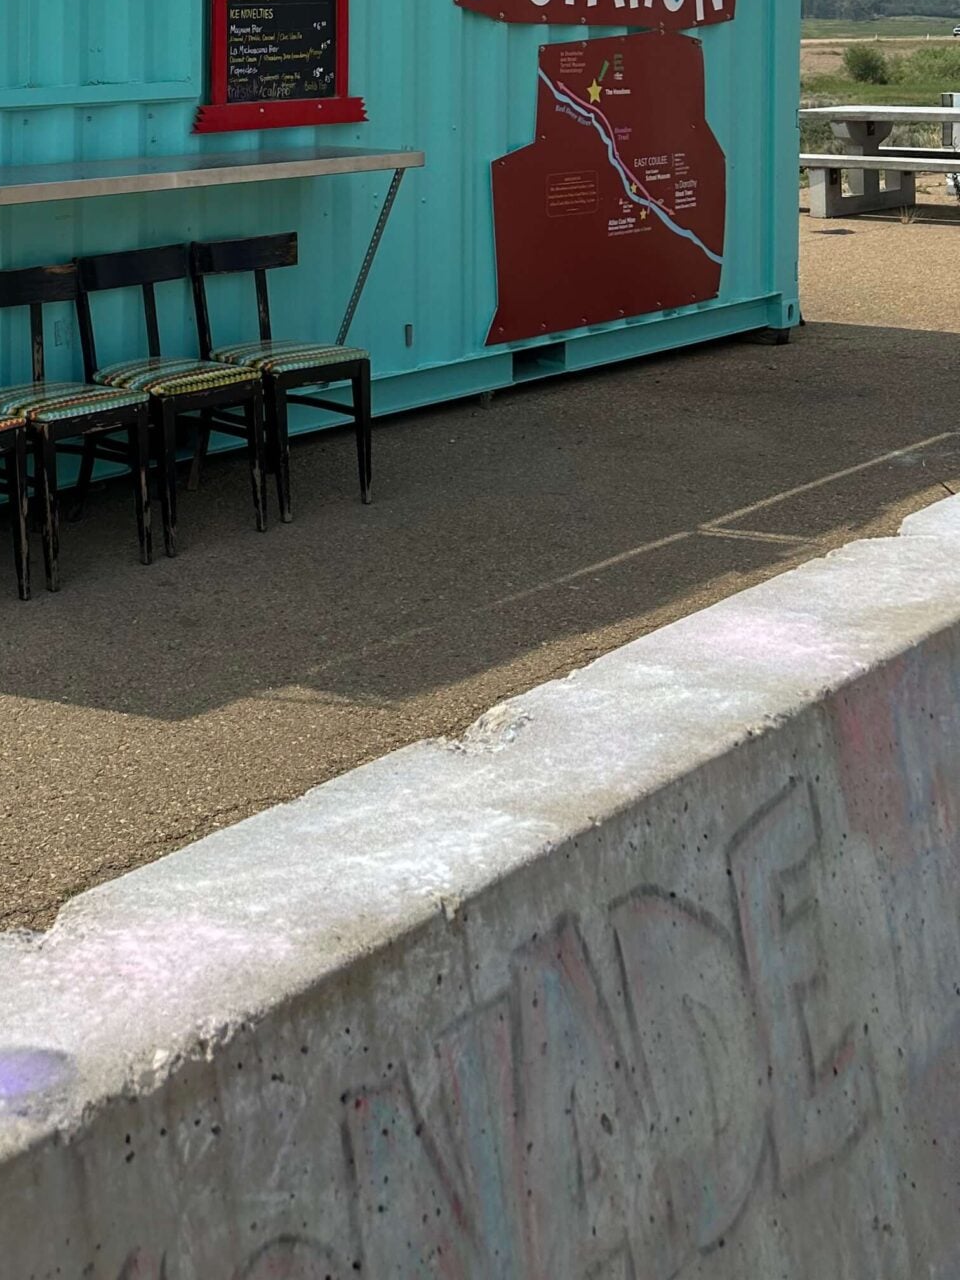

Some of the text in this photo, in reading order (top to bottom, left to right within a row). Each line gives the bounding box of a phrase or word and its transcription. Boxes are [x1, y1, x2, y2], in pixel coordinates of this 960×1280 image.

[230, 8, 274, 19] ICE NOVELTIES
[633, 157, 647, 167] EAST
[648, 155, 668, 165] COULEE
